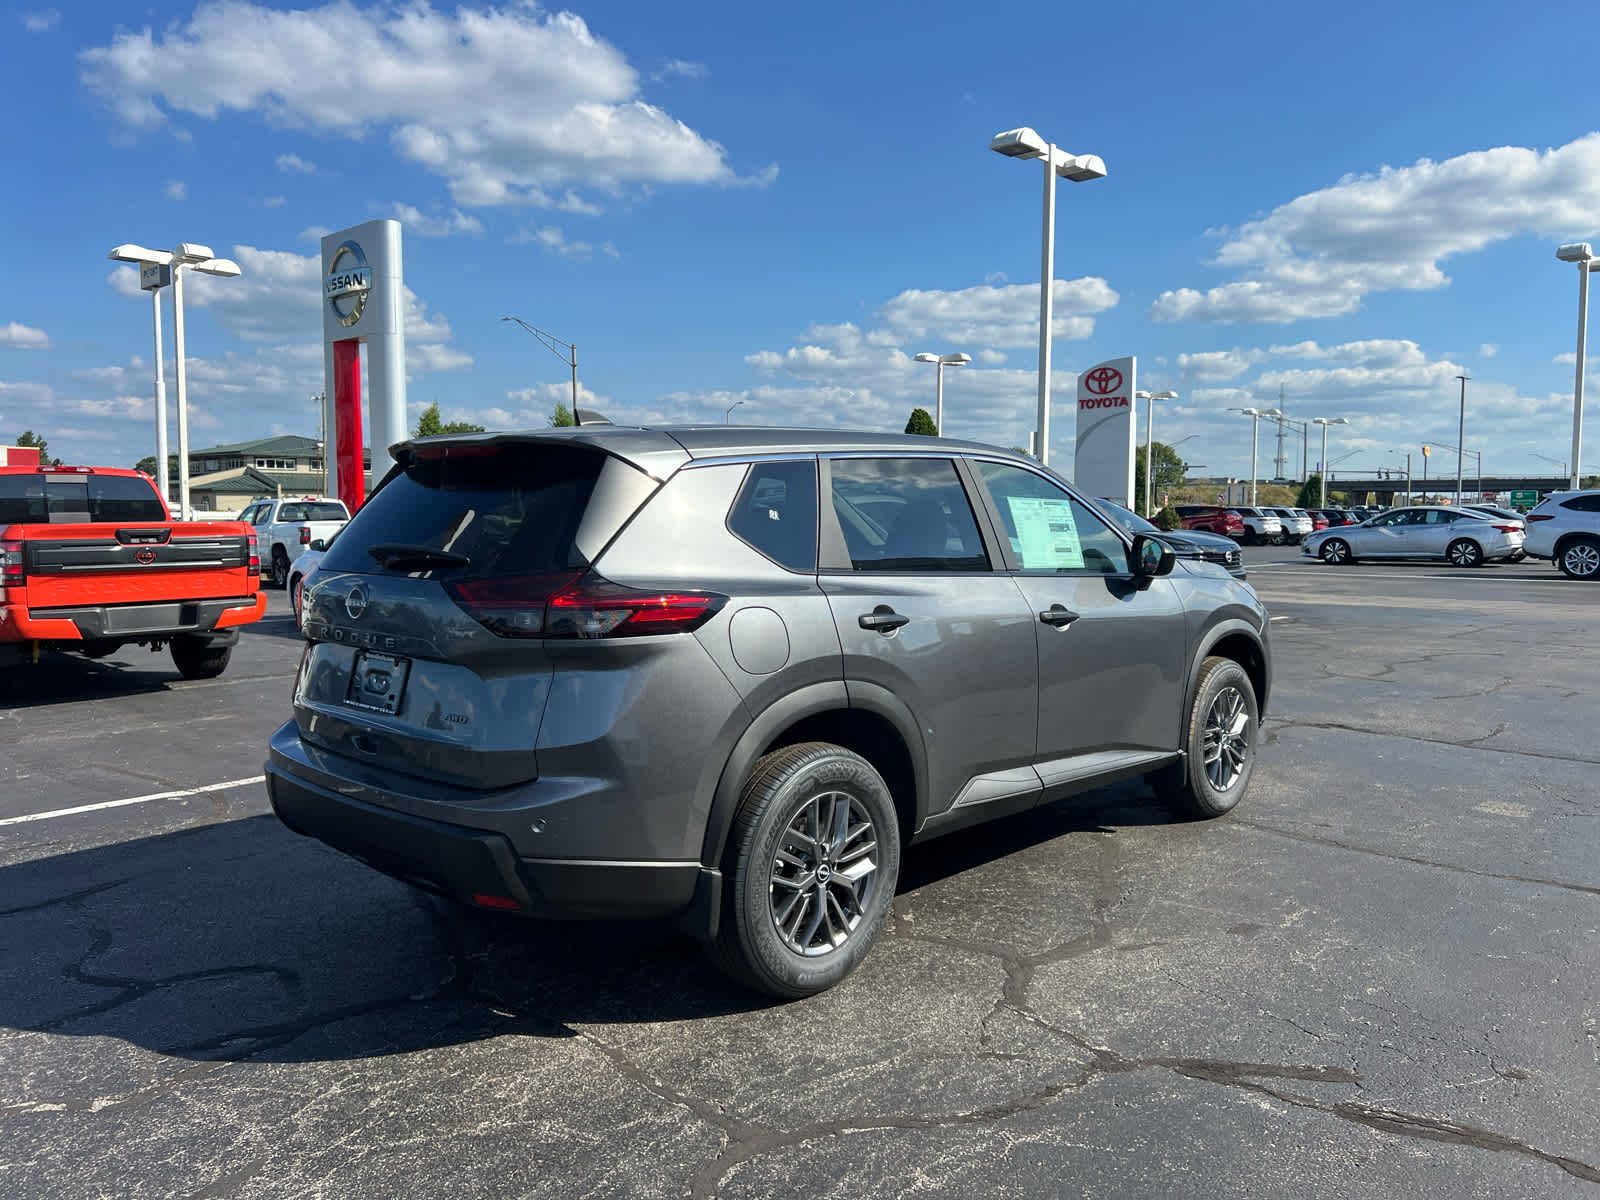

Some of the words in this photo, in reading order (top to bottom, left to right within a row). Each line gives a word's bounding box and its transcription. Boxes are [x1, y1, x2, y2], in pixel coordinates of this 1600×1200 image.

[327, 271, 363, 293] SSAN
[1079, 396, 1129, 410] TOYOTA
[320, 626, 395, 648] ROGUE
